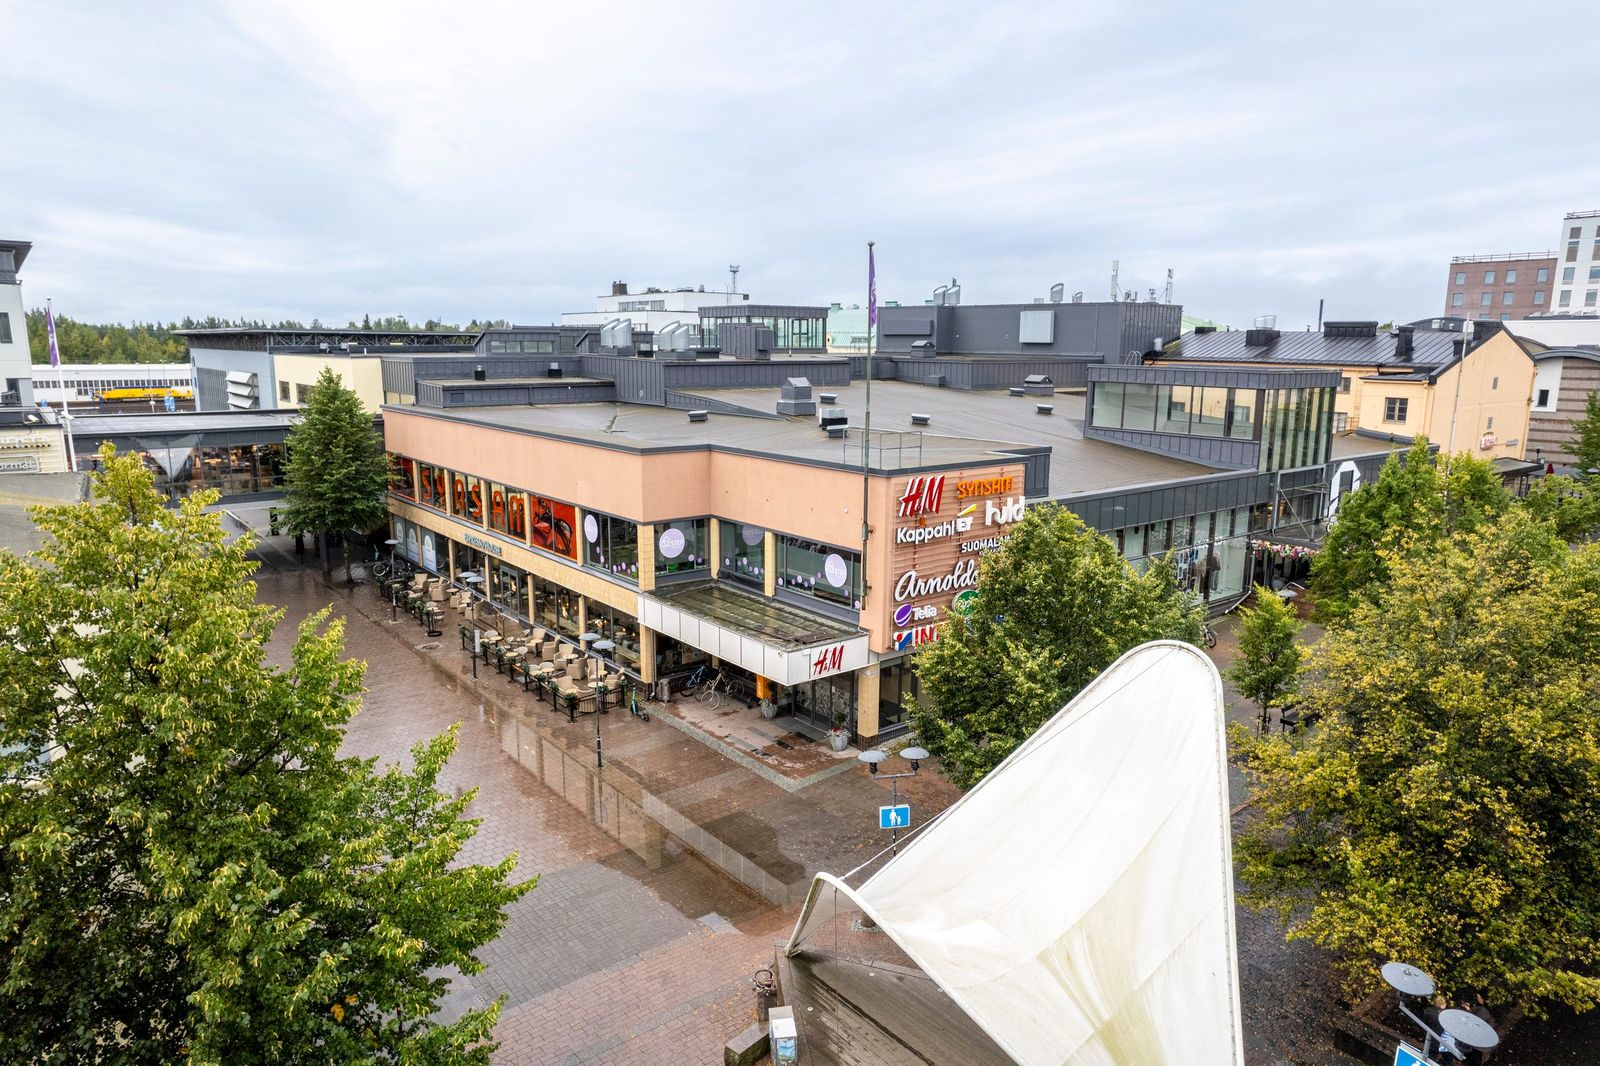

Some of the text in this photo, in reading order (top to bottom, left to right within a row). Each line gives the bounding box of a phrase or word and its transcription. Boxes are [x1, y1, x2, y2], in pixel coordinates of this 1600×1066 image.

[899, 475, 945, 517] H&M
[897, 520, 955, 545] Kappahl
[913, 604, 937, 621] Telia
[813, 644, 845, 675] H&M
